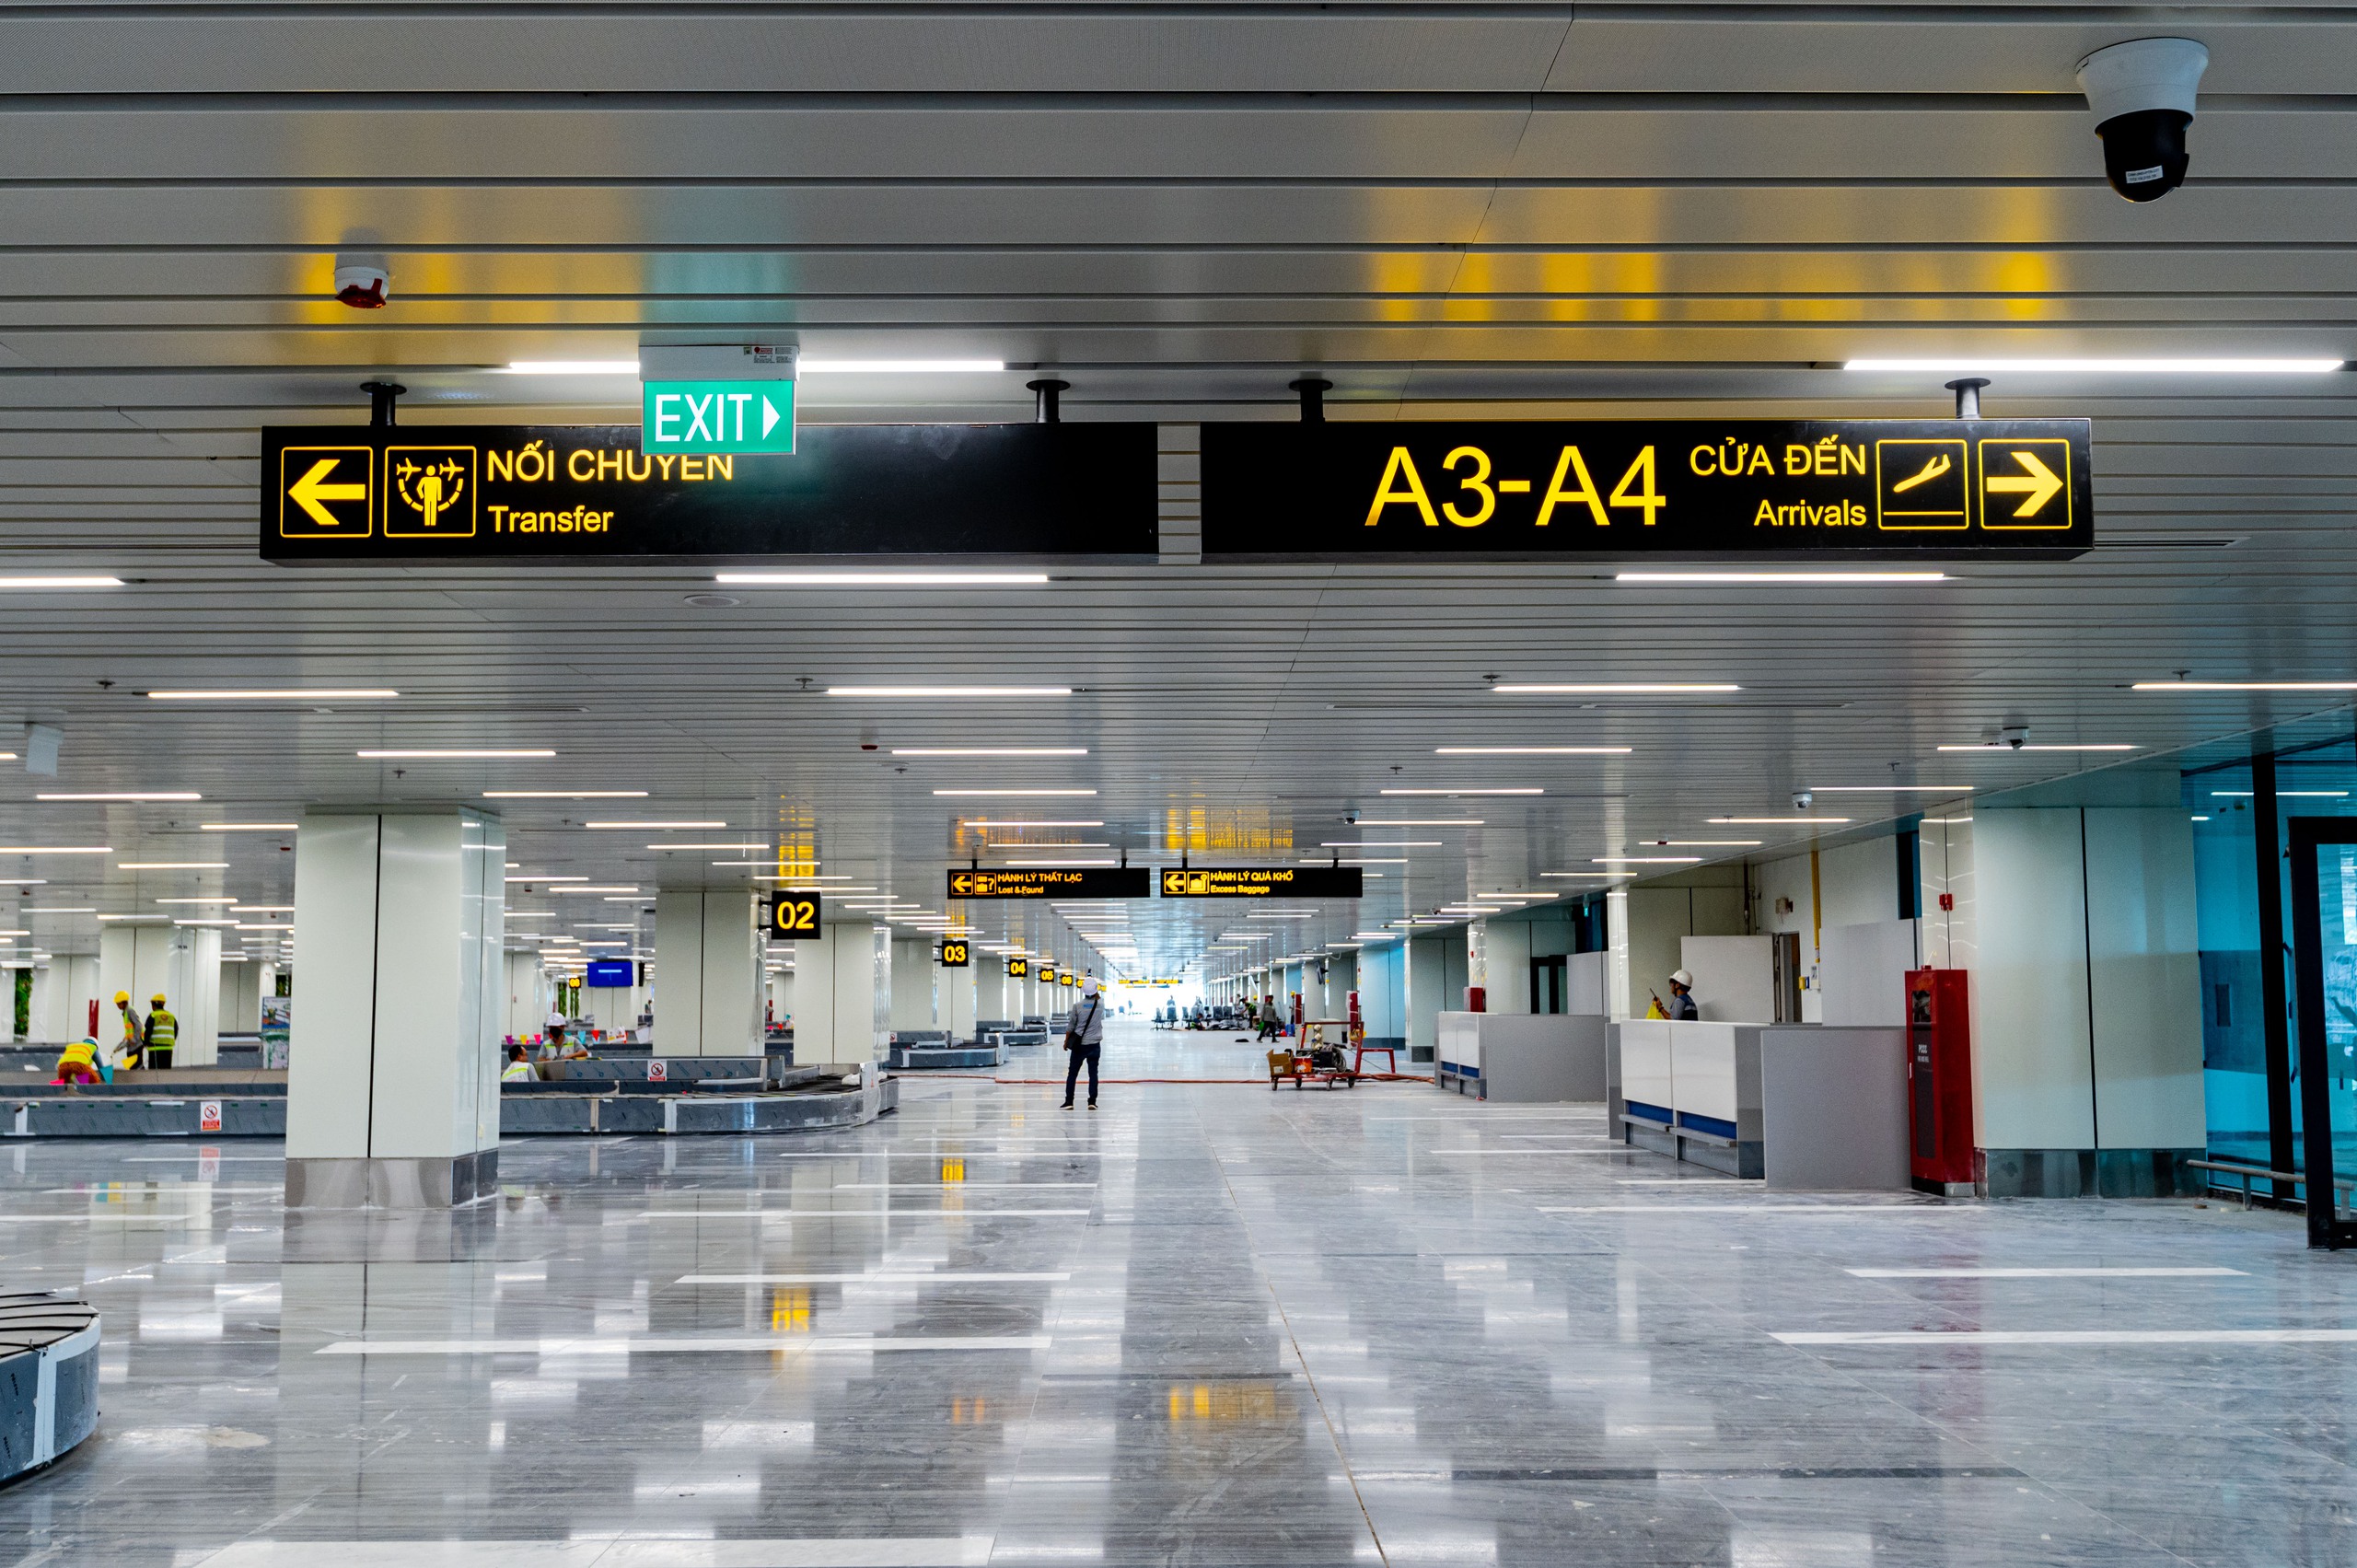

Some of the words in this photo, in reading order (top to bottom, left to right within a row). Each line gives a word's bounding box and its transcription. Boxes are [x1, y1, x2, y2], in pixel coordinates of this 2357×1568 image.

[655, 393, 752, 442] EXIT
[487, 440, 555, 482] NỐI
[1690, 436, 1775, 476] CỬA
[1783, 435, 1866, 475] ĐẾN
[1364, 446, 1666, 528] A3-A4
[487, 505, 615, 533] Transfer
[1753, 499, 1867, 527] Arrivals
[1064, 873, 1083, 884] LẠC
[1237, 870, 1250, 881] LÝ
[1251, 870, 1271, 881] QUÁ
[997, 886, 1014, 894] Lost
[1014, 886, 1022, 894] &
[1022, 886, 1044, 894] Found
[1210, 885, 1237, 893] Excess
[1237, 885, 1270, 894] Baggage
[777, 900, 815, 930] 02
[944, 945, 966, 962] 03
[1010, 962, 1026, 974] 04
[1040, 970, 1053, 981] 05
